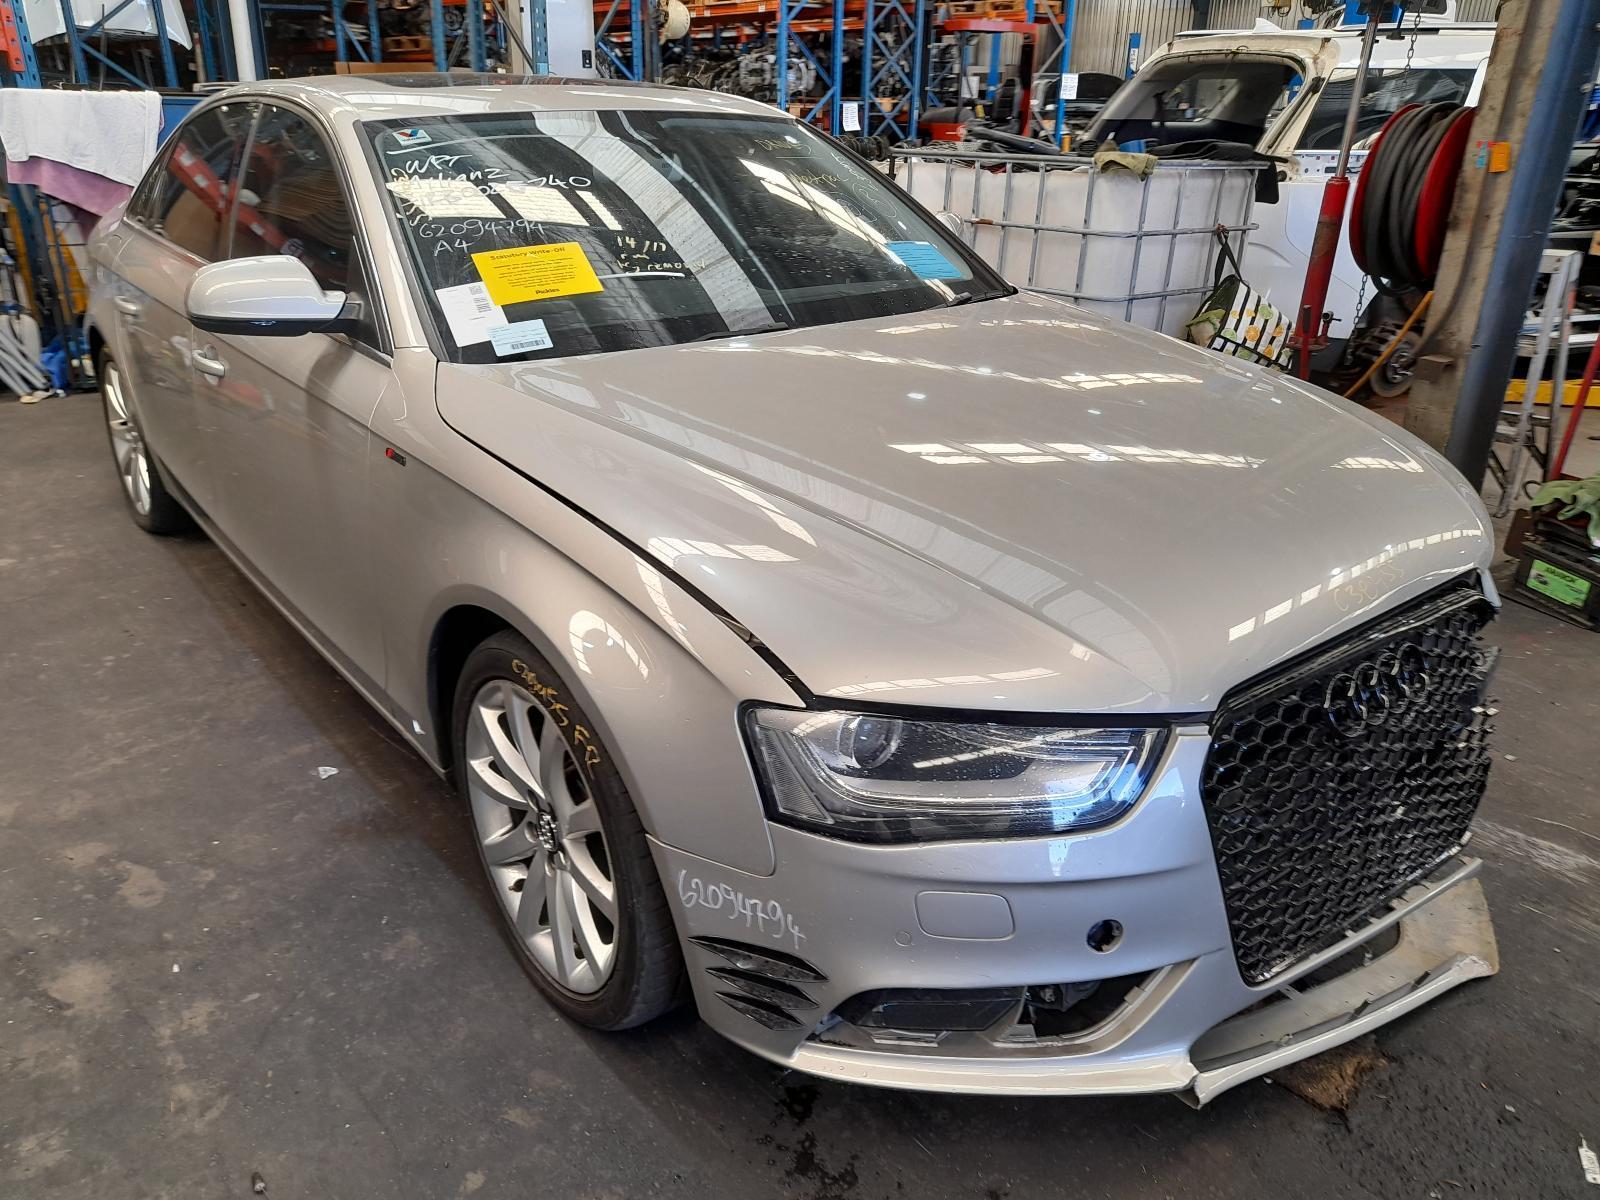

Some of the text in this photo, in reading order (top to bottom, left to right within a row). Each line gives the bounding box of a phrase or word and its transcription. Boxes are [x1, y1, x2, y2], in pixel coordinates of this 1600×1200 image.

[419, 219, 547, 238] 62094794
[433, 238, 474, 257] A4
[490, 250, 528, 261] Statutory
[535, 287, 560, 295] Pickles
[678, 869, 808, 950] 62094794
